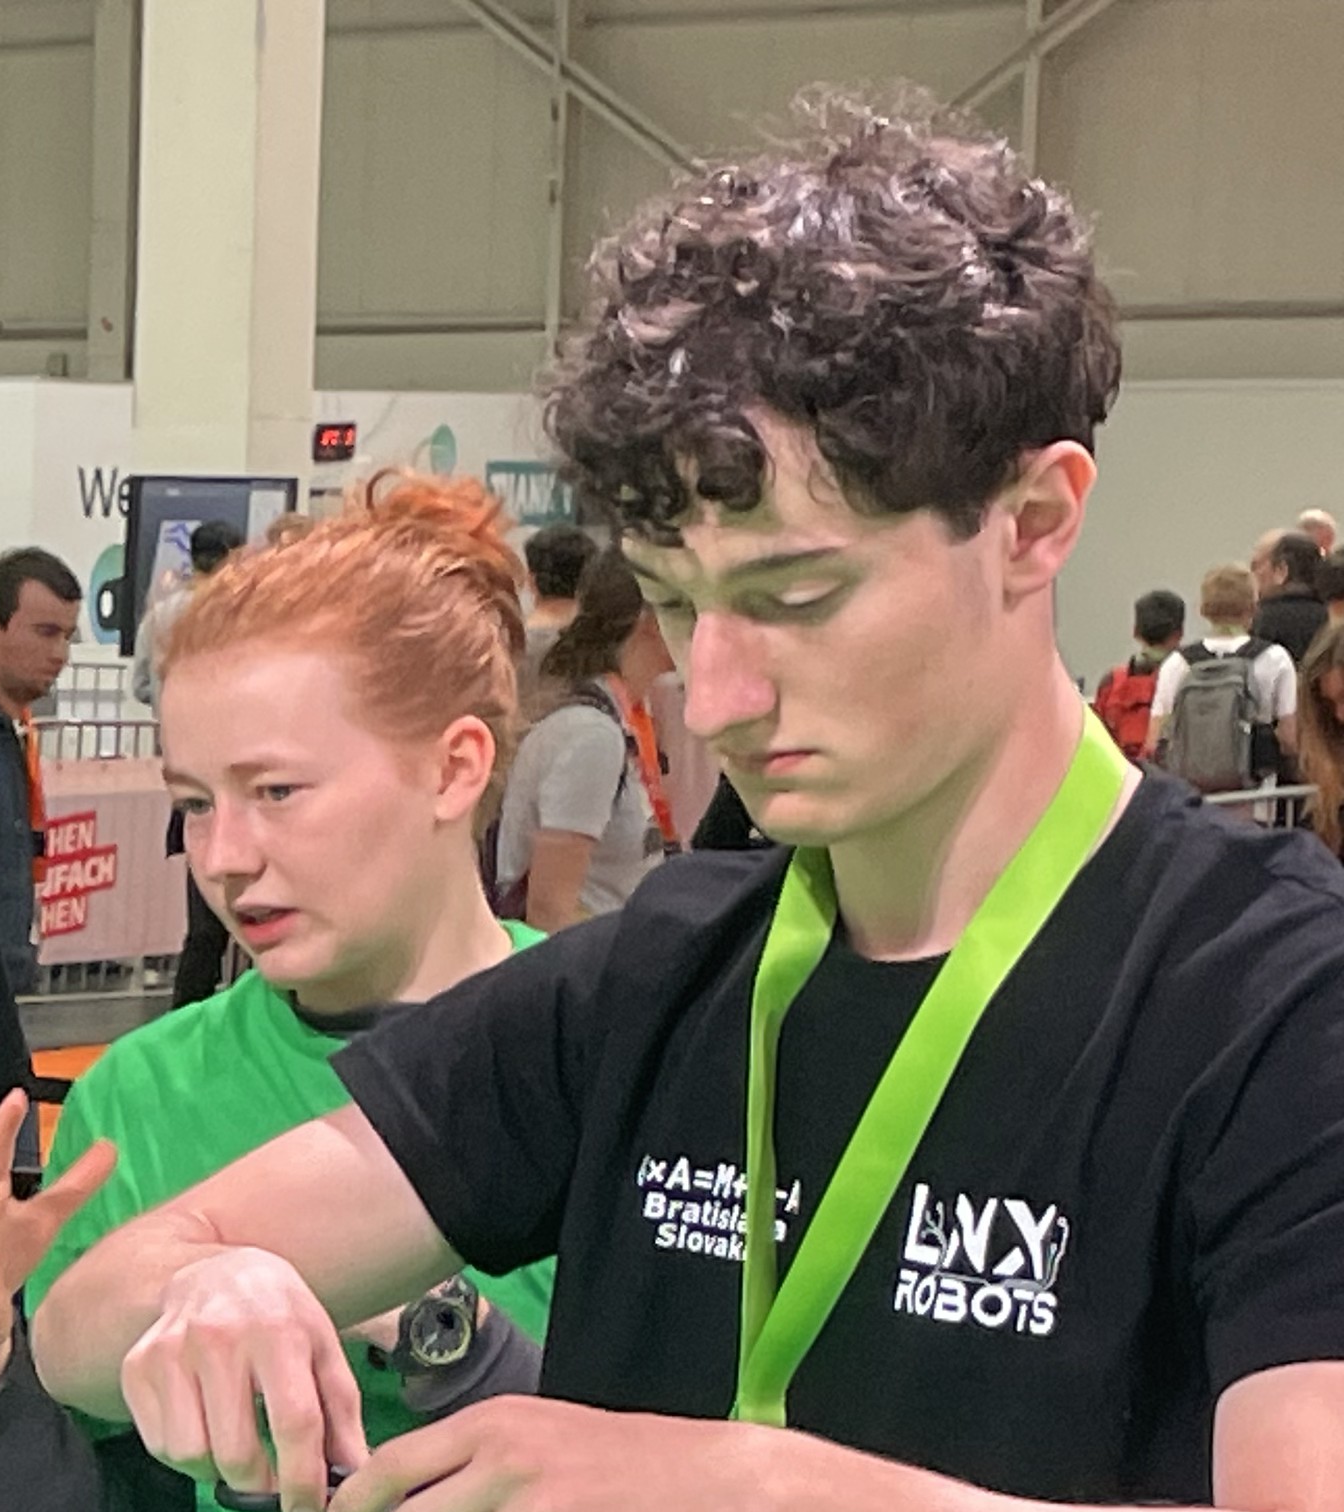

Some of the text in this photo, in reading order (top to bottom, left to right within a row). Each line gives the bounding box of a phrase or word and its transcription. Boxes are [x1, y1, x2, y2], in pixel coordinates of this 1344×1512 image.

[47, 818, 95, 858] HEN
[40, 895, 87, 935] HEN
[655, 1222, 748, 1261] Slovak
[894, 1270, 1058, 1336] ROBOTS
